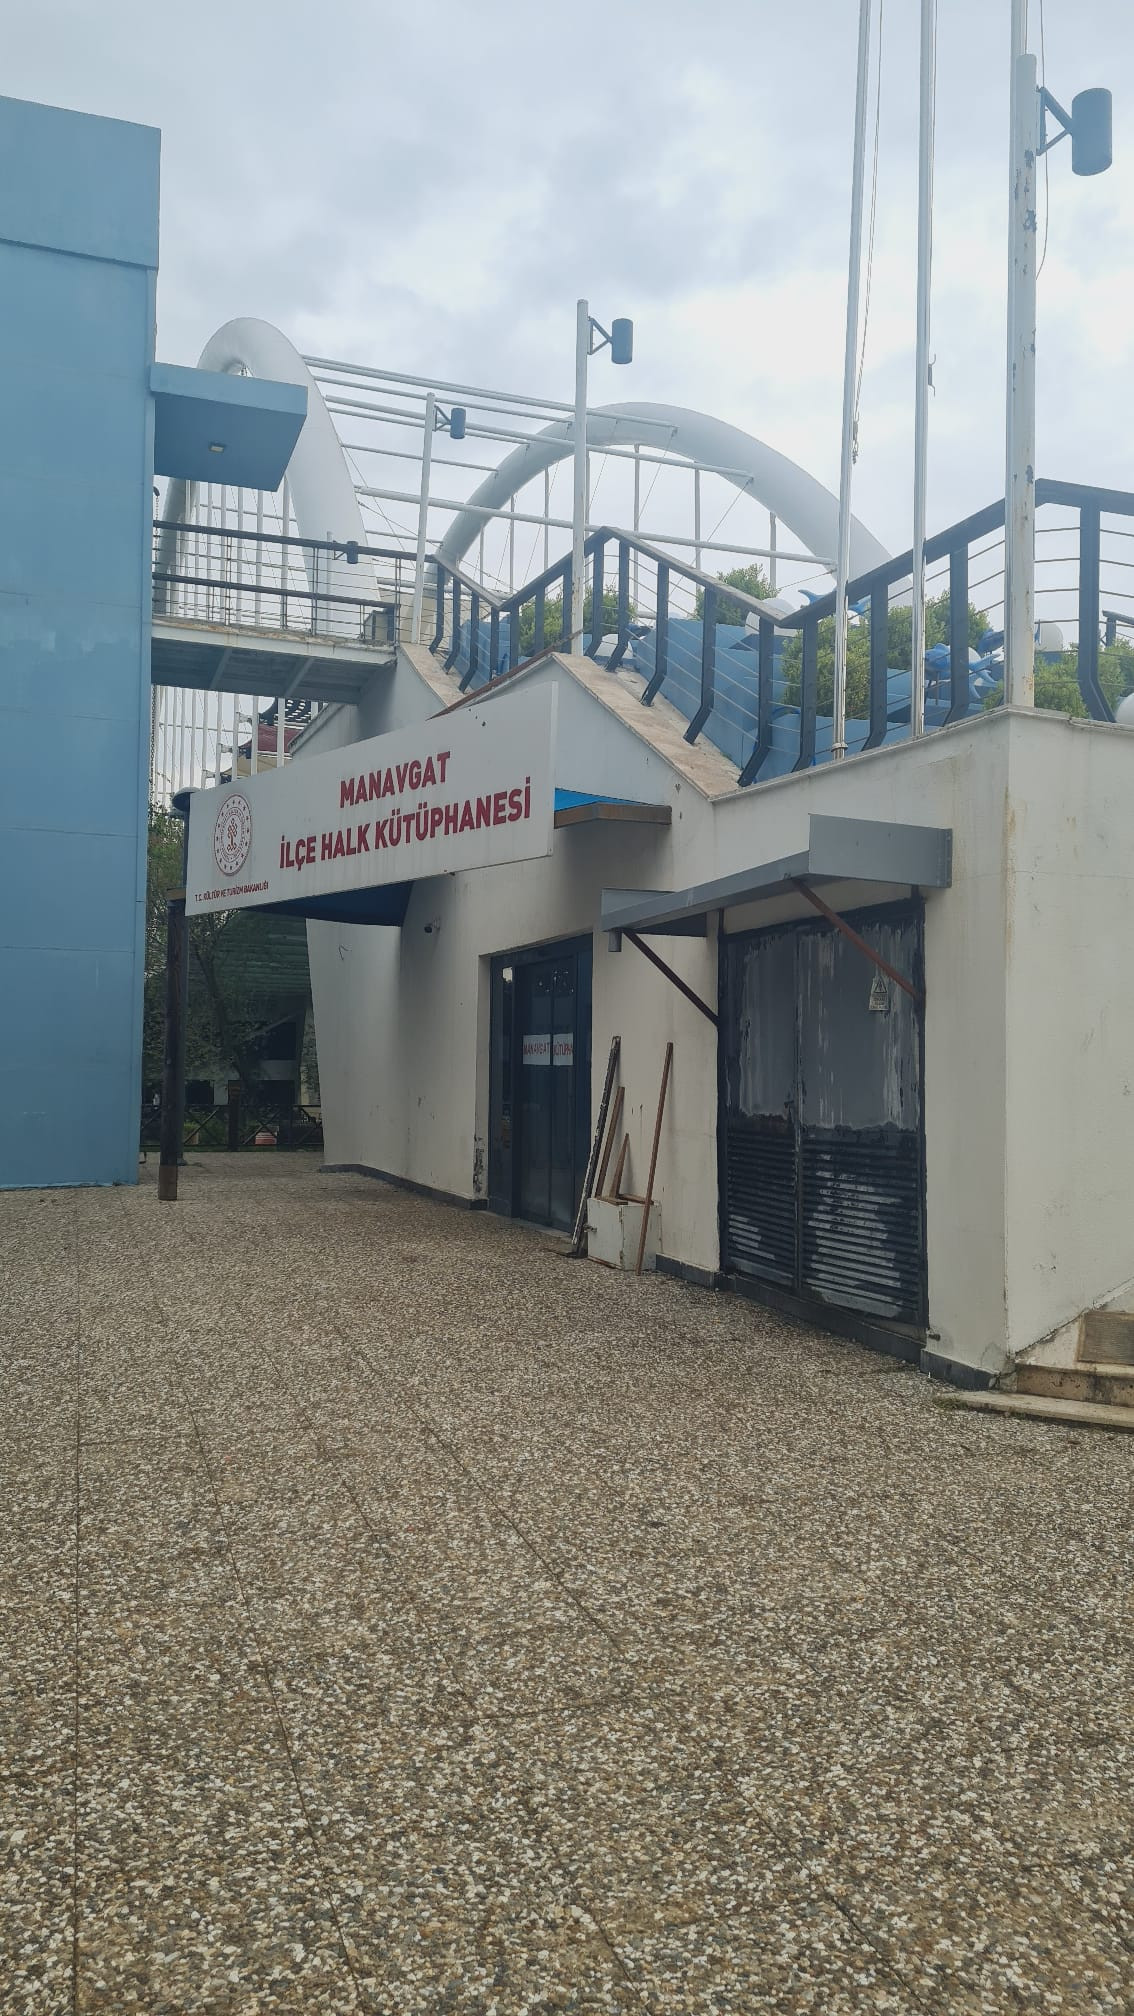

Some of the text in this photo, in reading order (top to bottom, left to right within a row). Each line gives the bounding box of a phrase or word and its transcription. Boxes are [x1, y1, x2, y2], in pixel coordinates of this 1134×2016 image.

[340, 751, 450, 808] MANAVGAT
[280, 835, 316, 871] İLÇE
[321, 823, 370, 861] HALK
[375, 776, 531, 850] KÜTÜPHANESİ
